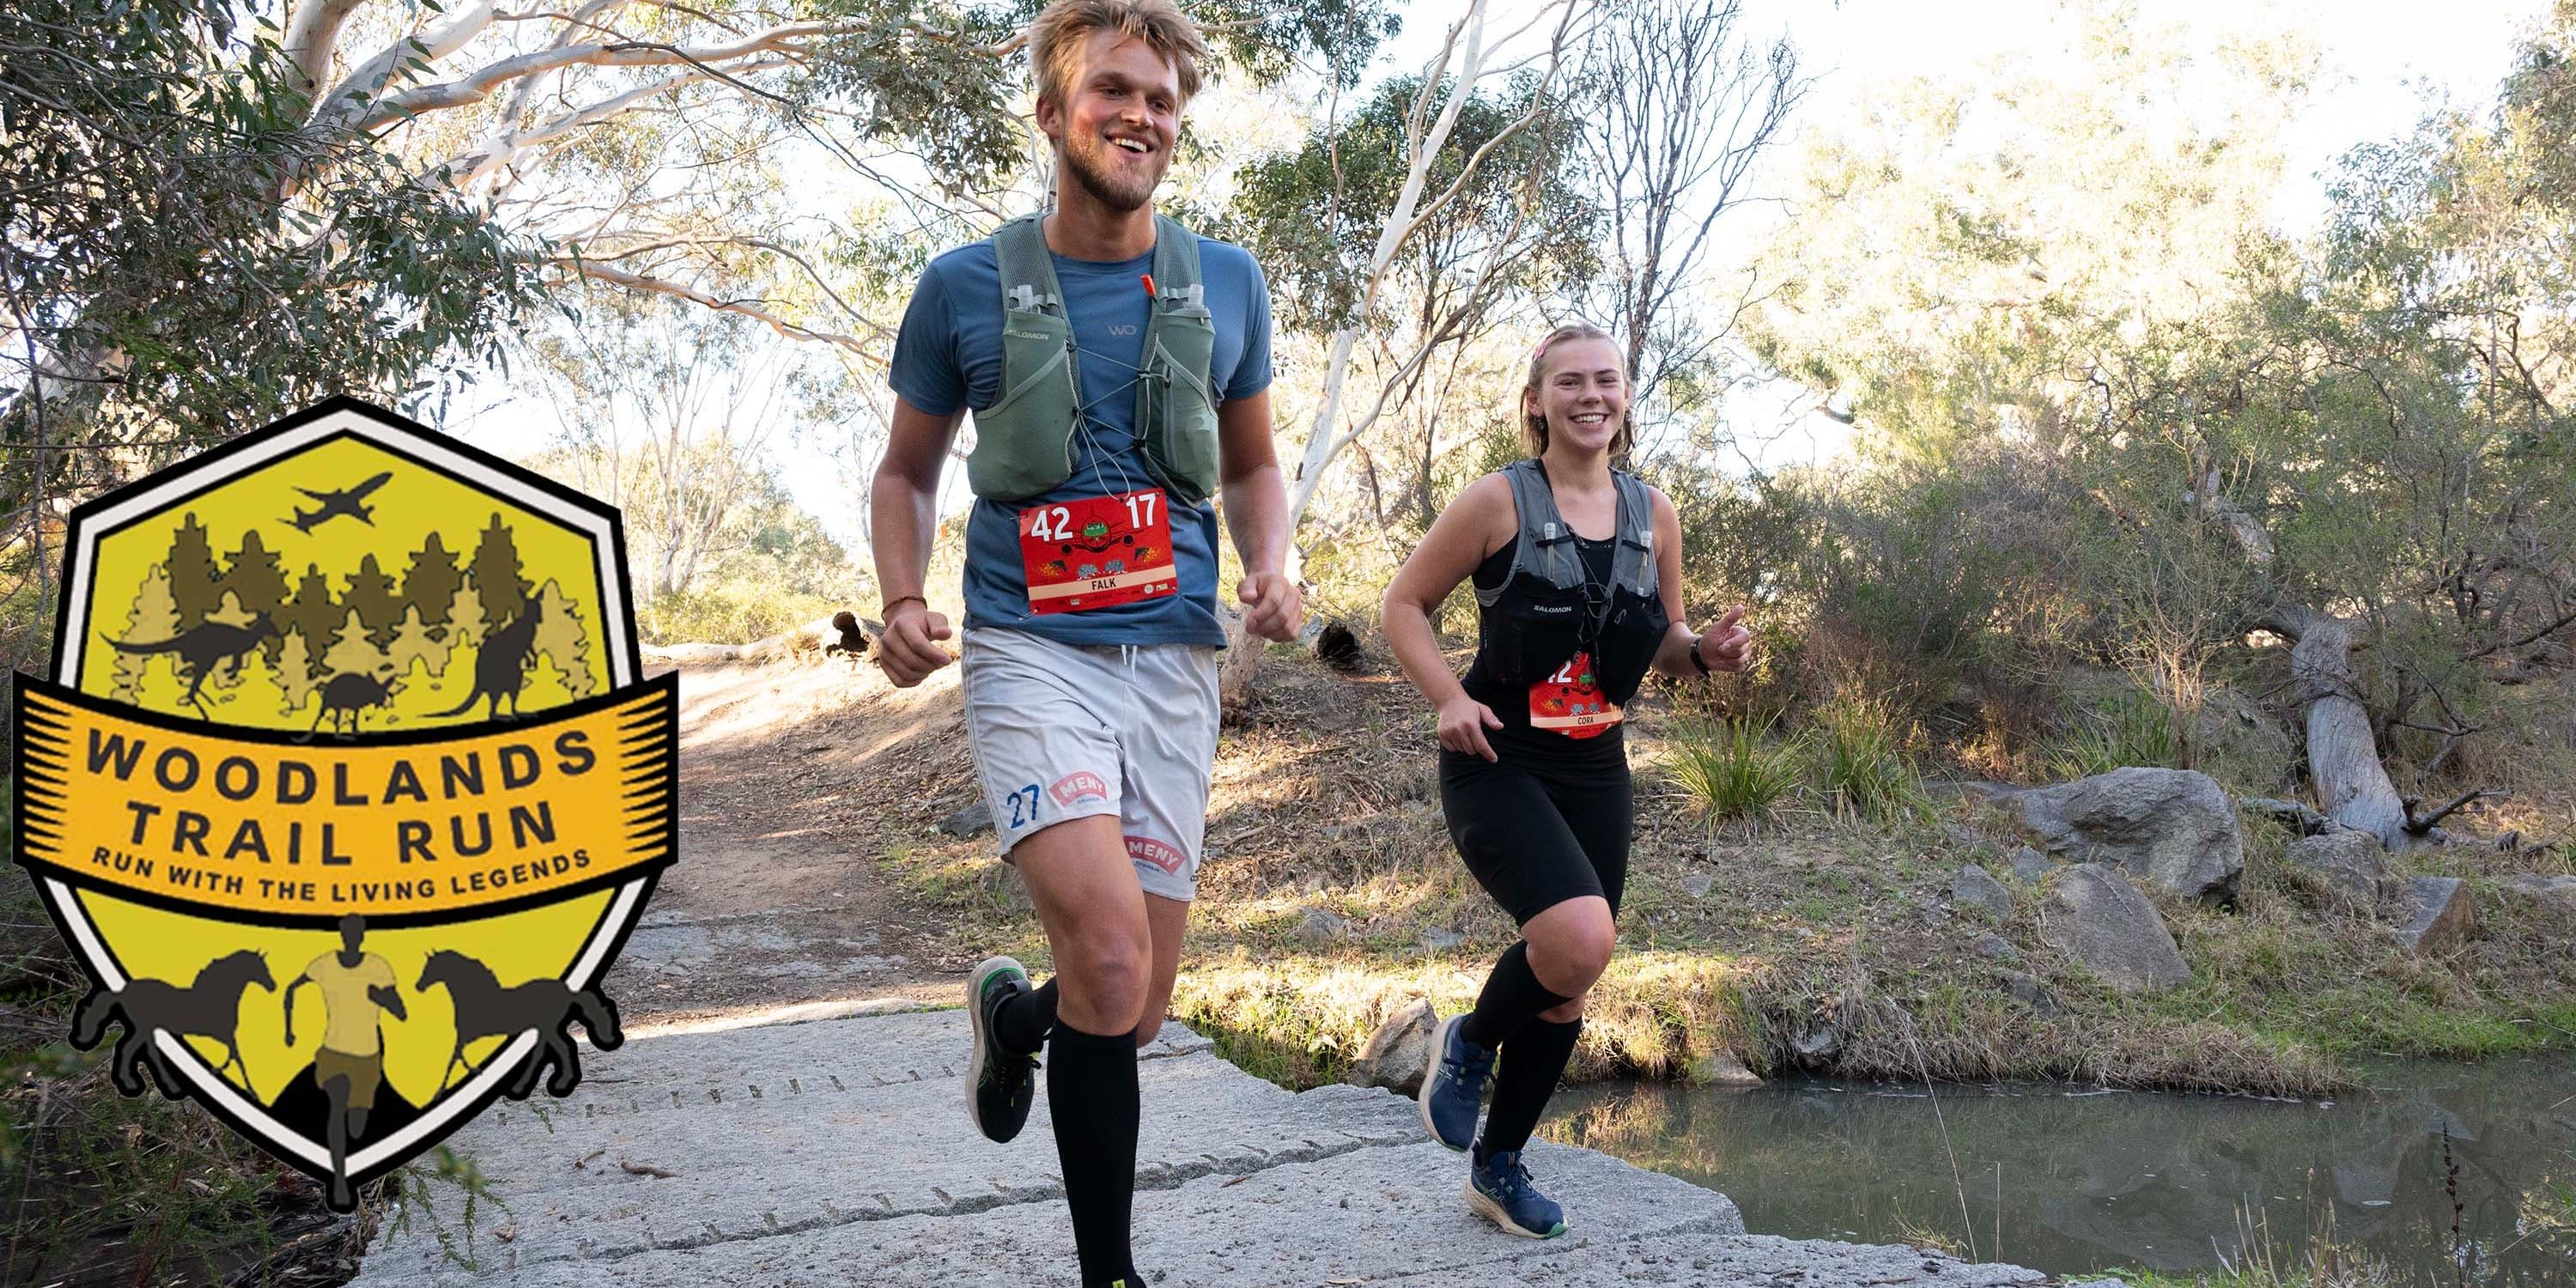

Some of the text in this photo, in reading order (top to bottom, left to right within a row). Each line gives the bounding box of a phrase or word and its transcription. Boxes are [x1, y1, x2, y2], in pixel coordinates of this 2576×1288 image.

[1030, 493, 1156, 542] 42 17
[1091, 578, 1116, 591] FALK
[1533, 605, 1572, 614] SALOMON
[1577, 716, 1595, 725] CORA
[1059, 776, 1104, 798] MENY
[1006, 784, 1040, 829] 27
[1128, 841, 1179, 866] MENY
